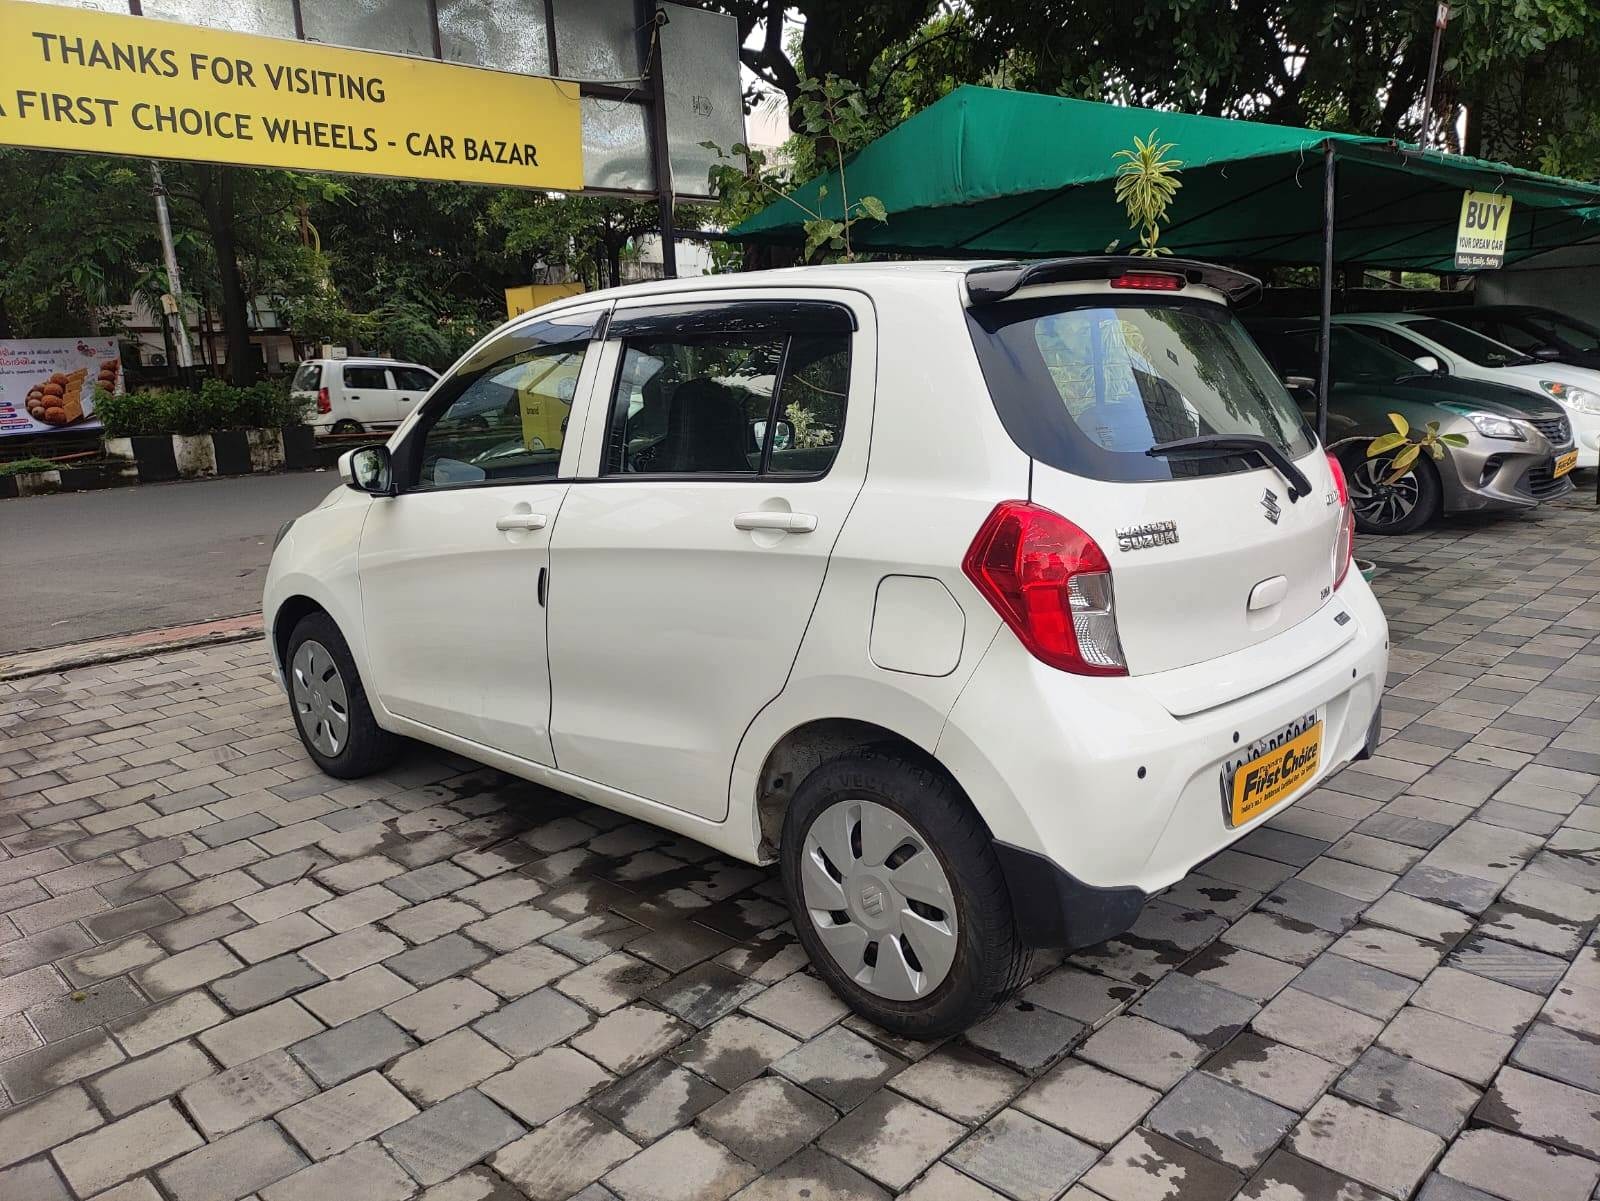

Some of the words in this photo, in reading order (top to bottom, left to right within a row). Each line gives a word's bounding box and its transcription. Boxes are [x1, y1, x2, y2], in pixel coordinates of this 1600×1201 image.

[32, 31, 179, 78] THANKS
[191, 53, 257, 88] FOR
[263, 63, 386, 103] VISITING
[16, 90, 119, 127] FIRST
[131, 102, 254, 141] CHOICE
[261, 116, 378, 152] WHEELS
[405, 132, 457, 160] CAR
[463, 137, 539, 167] BAZAR
[1466, 201, 1505, 230] BUY
[1472, 238, 1490, 249] DREAM
[1491, 239, 1504, 251] CAR
[1115, 520, 1177, 538] MARUTI
[1119, 531, 1180, 552] SUZUKI
